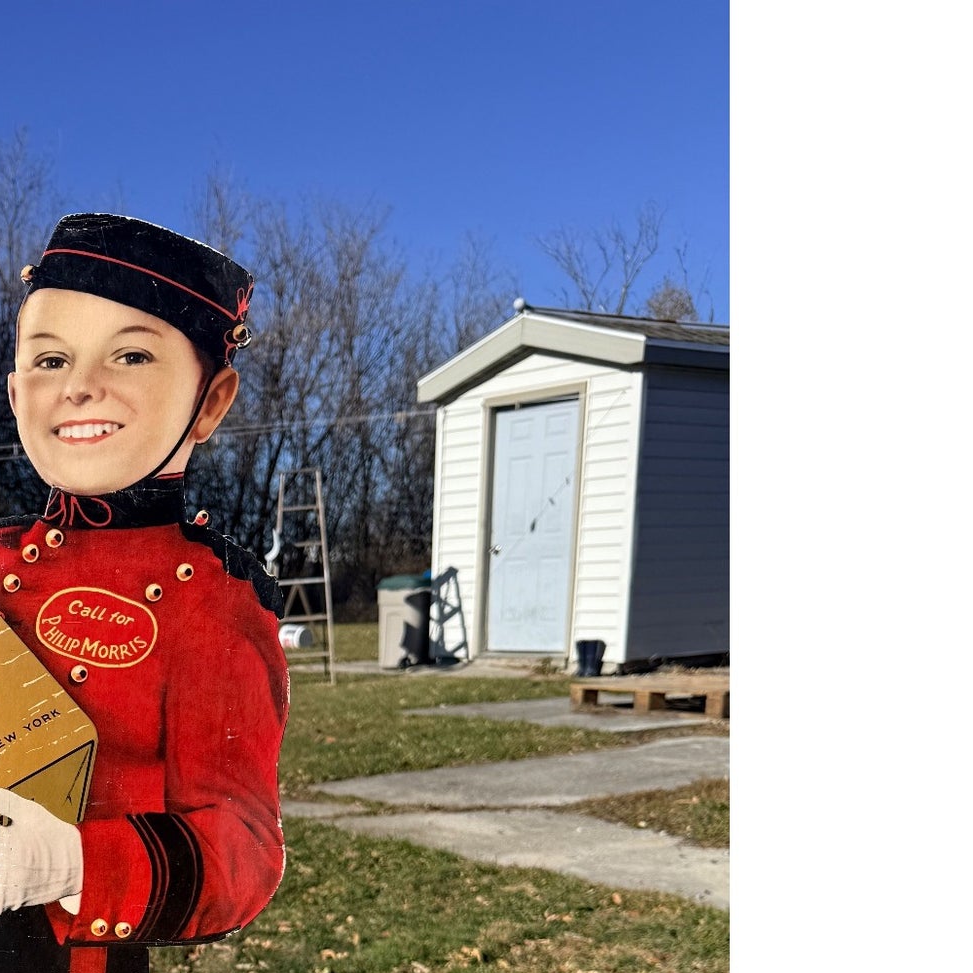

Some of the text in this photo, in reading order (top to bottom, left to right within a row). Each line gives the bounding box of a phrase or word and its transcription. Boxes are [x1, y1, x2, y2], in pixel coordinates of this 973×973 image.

[68, 600, 135, 626] Call for
[42, 615, 148, 661] PHILIP MORRIS
[23, 708, 62, 733] YORK
